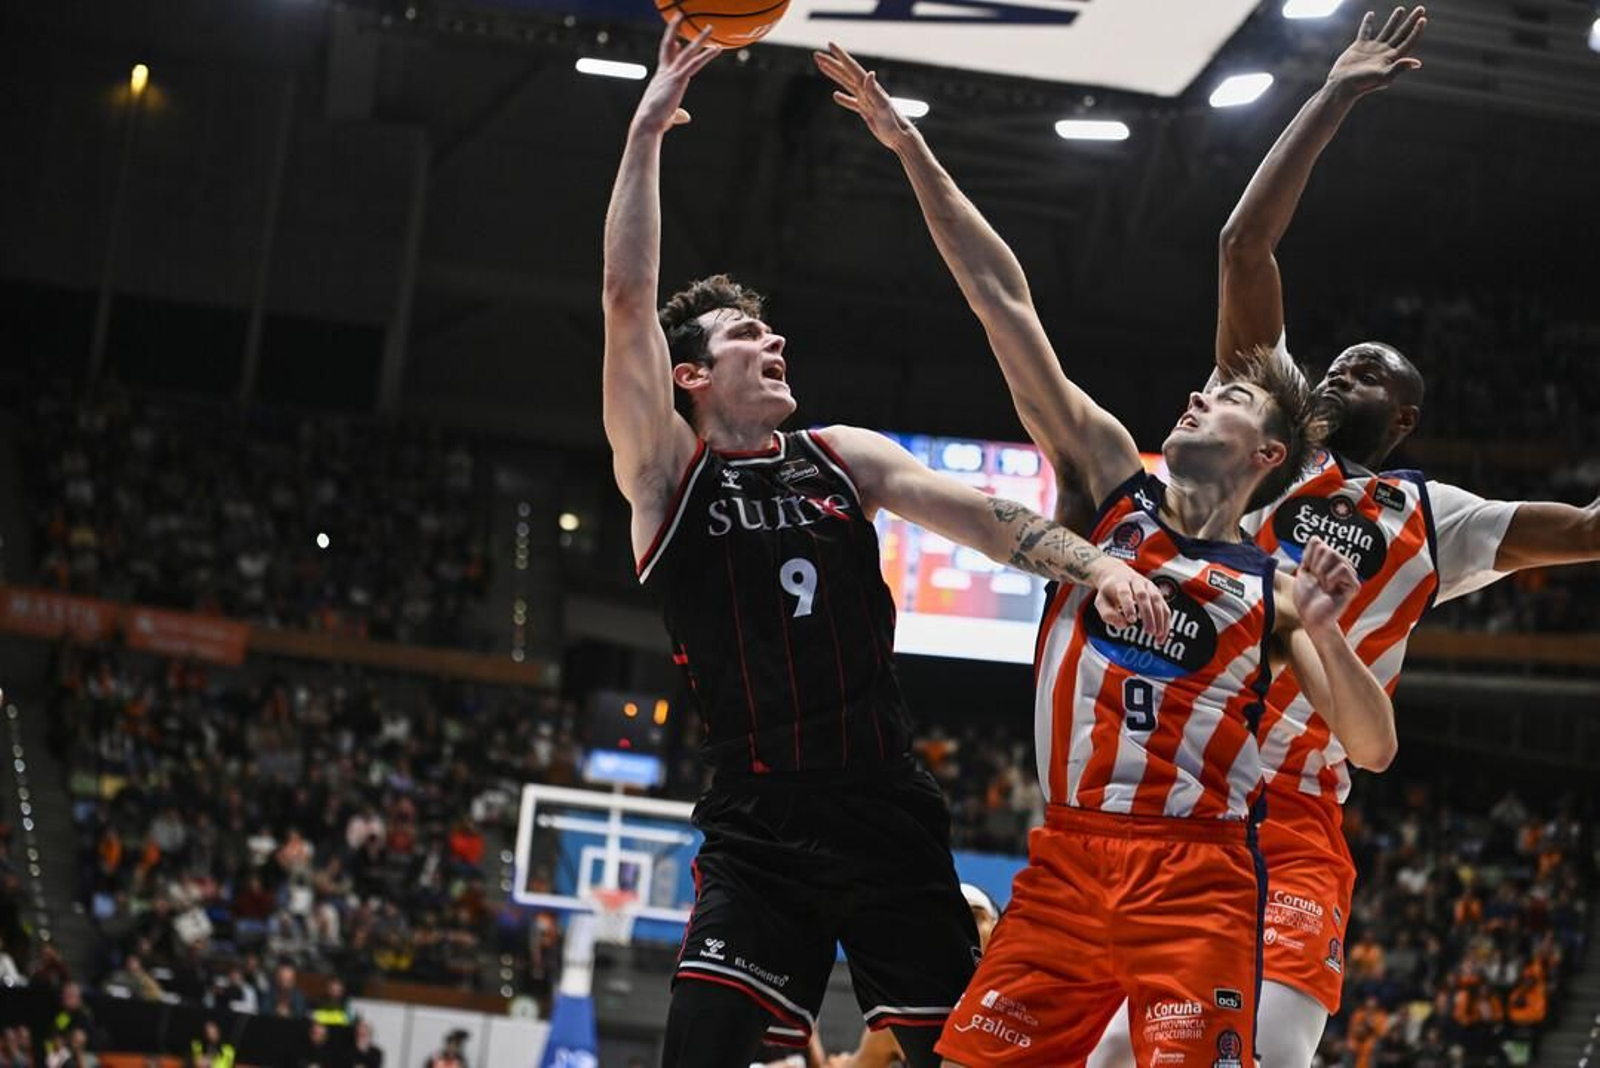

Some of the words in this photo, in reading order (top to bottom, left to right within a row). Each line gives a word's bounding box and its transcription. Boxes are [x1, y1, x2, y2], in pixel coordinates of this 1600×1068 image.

[1294, 504, 1374, 551] Estrella
[779, 557, 818, 618] 9
[1124, 679, 1157, 732] 9
[1274, 890, 1324, 916] Coruña
[734, 956, 748, 969] EL
[1154, 999, 1202, 1017] Coruña
[1218, 996, 1238, 1008] acb
[954, 1013, 1032, 1049] galicia
